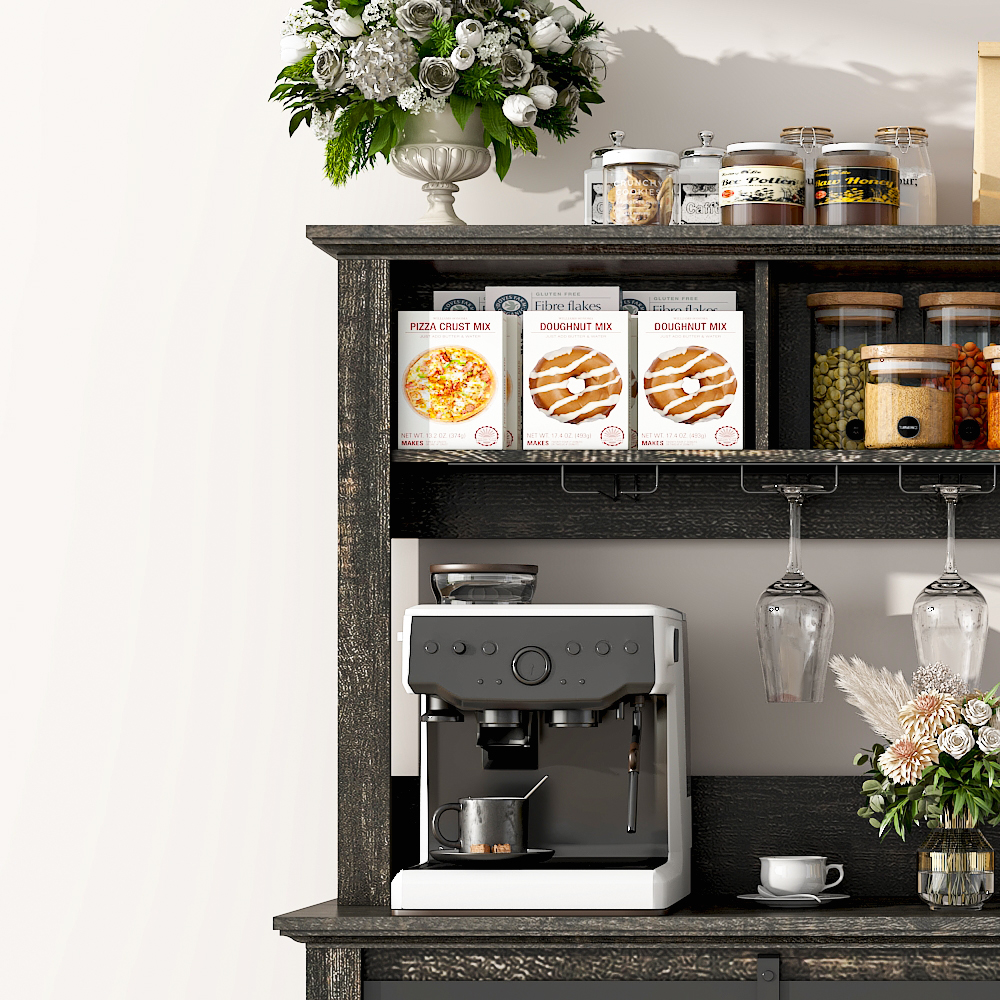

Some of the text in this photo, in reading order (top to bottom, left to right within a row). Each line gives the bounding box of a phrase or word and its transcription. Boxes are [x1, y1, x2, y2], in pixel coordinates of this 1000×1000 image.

[746, 177, 796, 186] Pollen
[845, 177, 894, 188] Honey
[616, 188, 660, 196] COOKIES
[535, 300, 602, 311] Fibre flakes
[410, 322, 491, 331] PIZZA CRUST MIX
[540, 322, 612, 331] DOUGHNUT MIX
[654, 322, 727, 331] DOUGHNUT MIX
